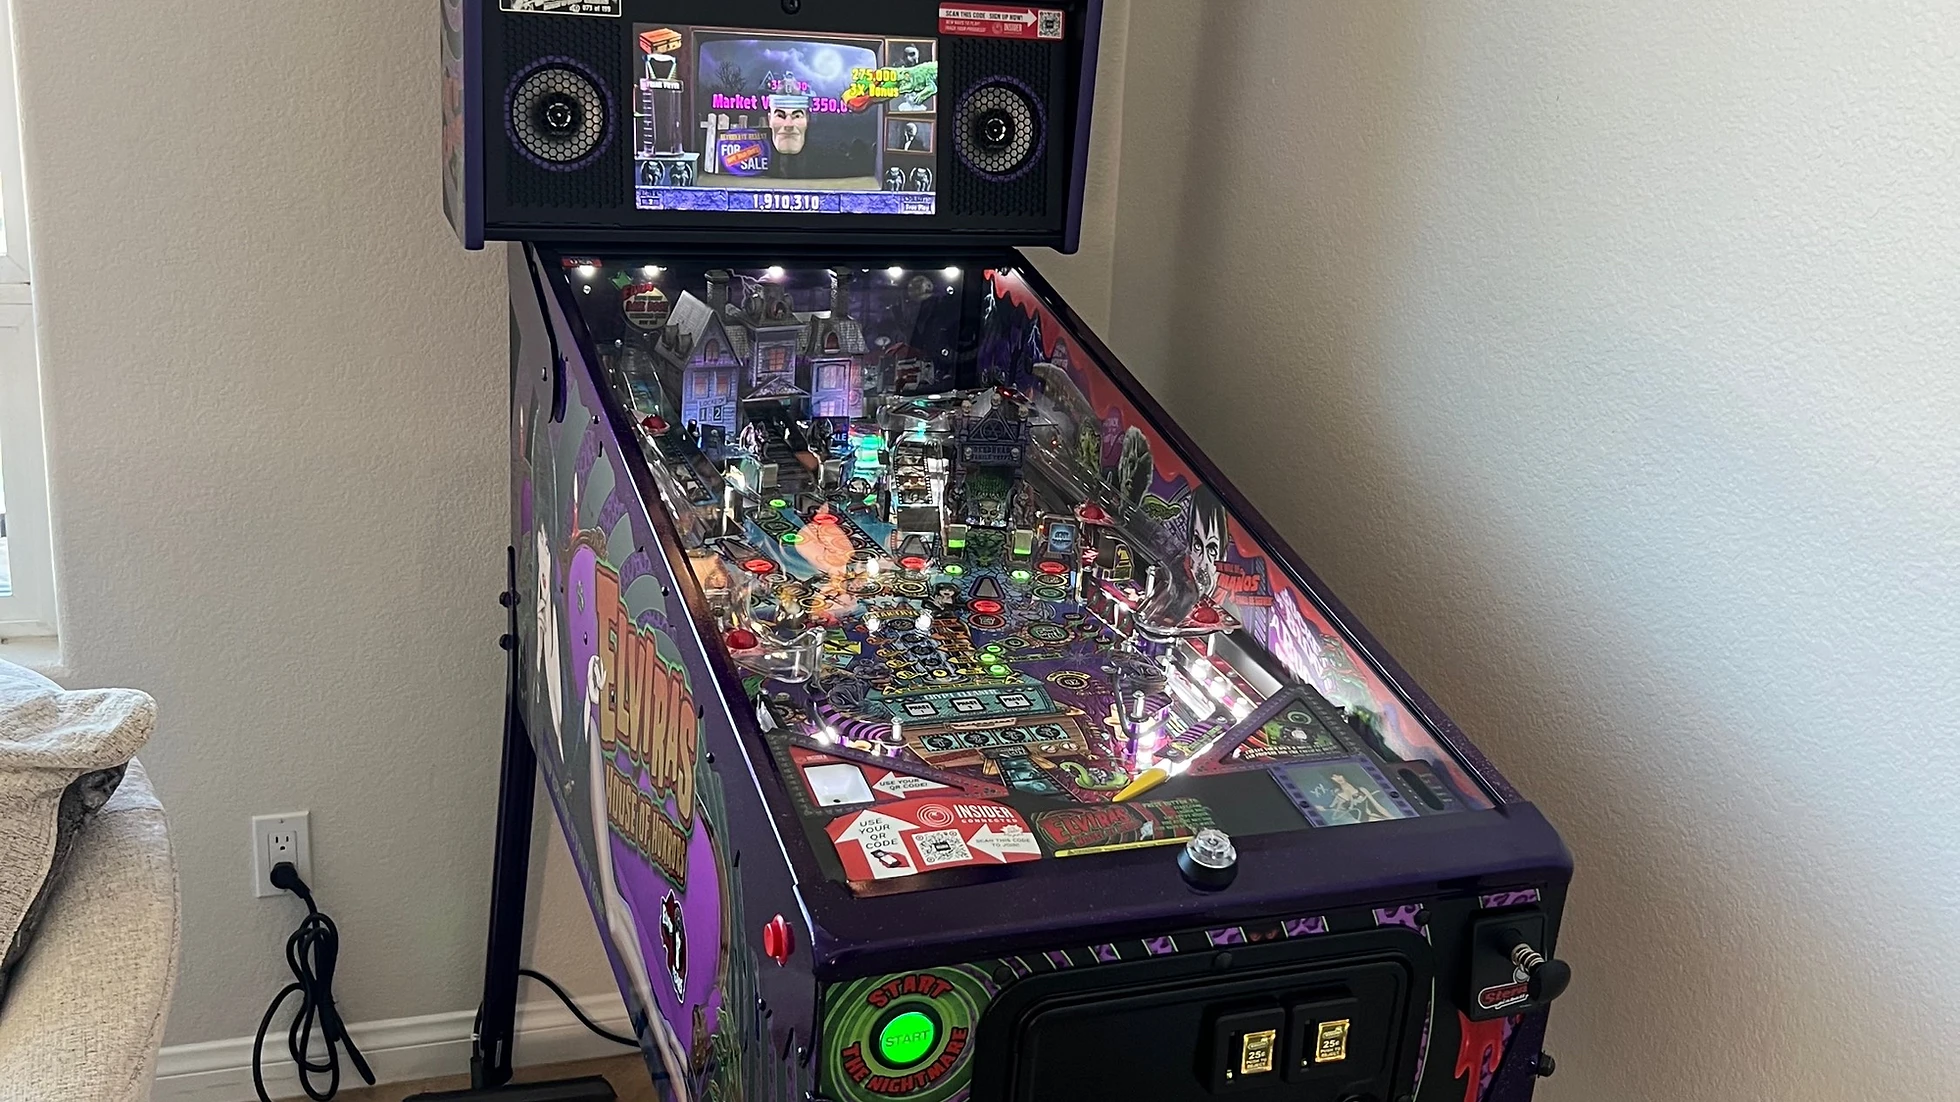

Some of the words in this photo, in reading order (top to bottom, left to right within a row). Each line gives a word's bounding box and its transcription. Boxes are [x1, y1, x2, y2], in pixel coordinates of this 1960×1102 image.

[973, 11, 985, 19] CODE
[1002, 12, 1009, 20] UP
[850, 84, 865, 97] 3X
[870, 83, 899, 98] Bonus
[712, 93, 758, 110] Market
[721, 144, 741, 156] FOR
[740, 157, 768, 170] SALE
[753, 193, 820, 210] 1,910,310
[714, 407, 721, 419] 2
[605, 763, 638, 835] HOUSE
[638, 799, 651, 846] OF
[953, 804, 1014, 819] INSIDER
[859, 817, 883, 827] USE
[859, 823, 890, 835] YOUR
[869, 833, 887, 841] QR
[865, 838, 898, 850] CODE
[867, 974, 954, 1008] START
[886, 1030, 930, 1048] START
[1322, 1040, 1340, 1049] 25¢
[841, 1040, 872, 1083] THE
[865, 1027, 968, 1093] NIGHTMARE
[1248, 1050, 1266, 1060] 25¢
